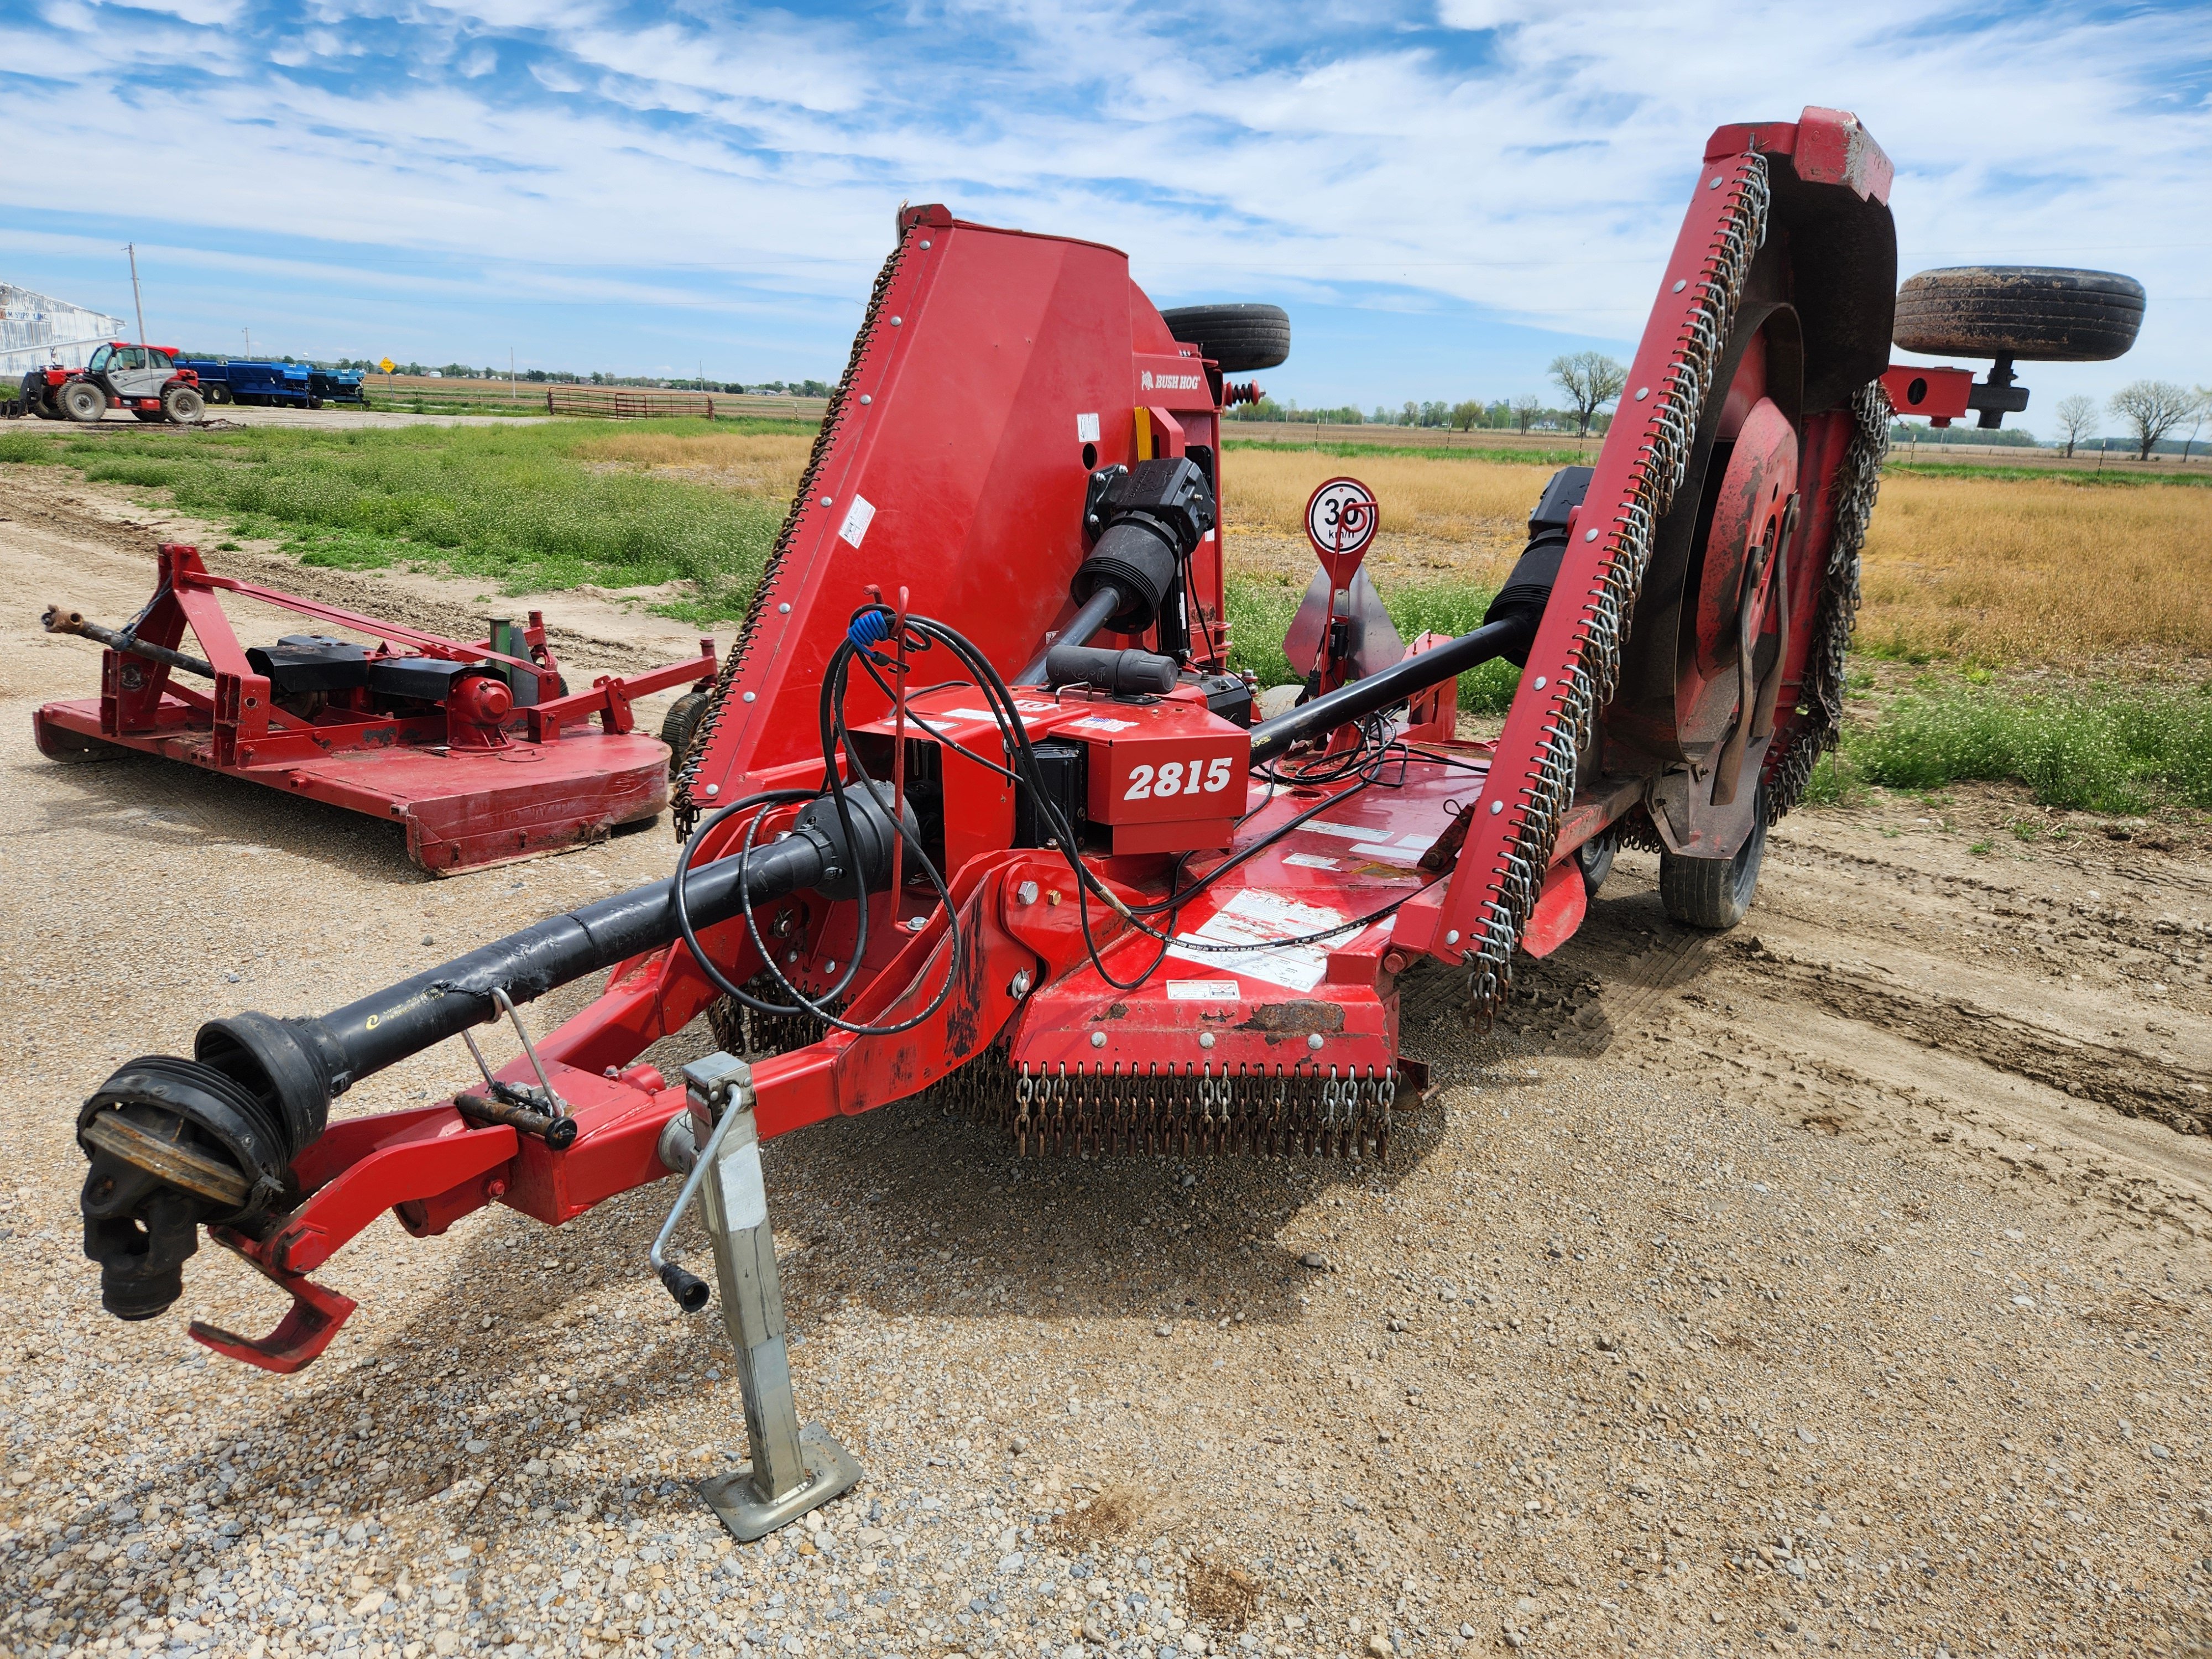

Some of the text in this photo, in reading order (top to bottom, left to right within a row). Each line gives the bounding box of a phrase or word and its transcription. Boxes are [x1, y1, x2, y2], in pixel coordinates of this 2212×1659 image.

[1155, 375, 1198, 389] BUSH HOG
[1324, 498, 1359, 526] 30
[1124, 758, 1233, 800] 2815
